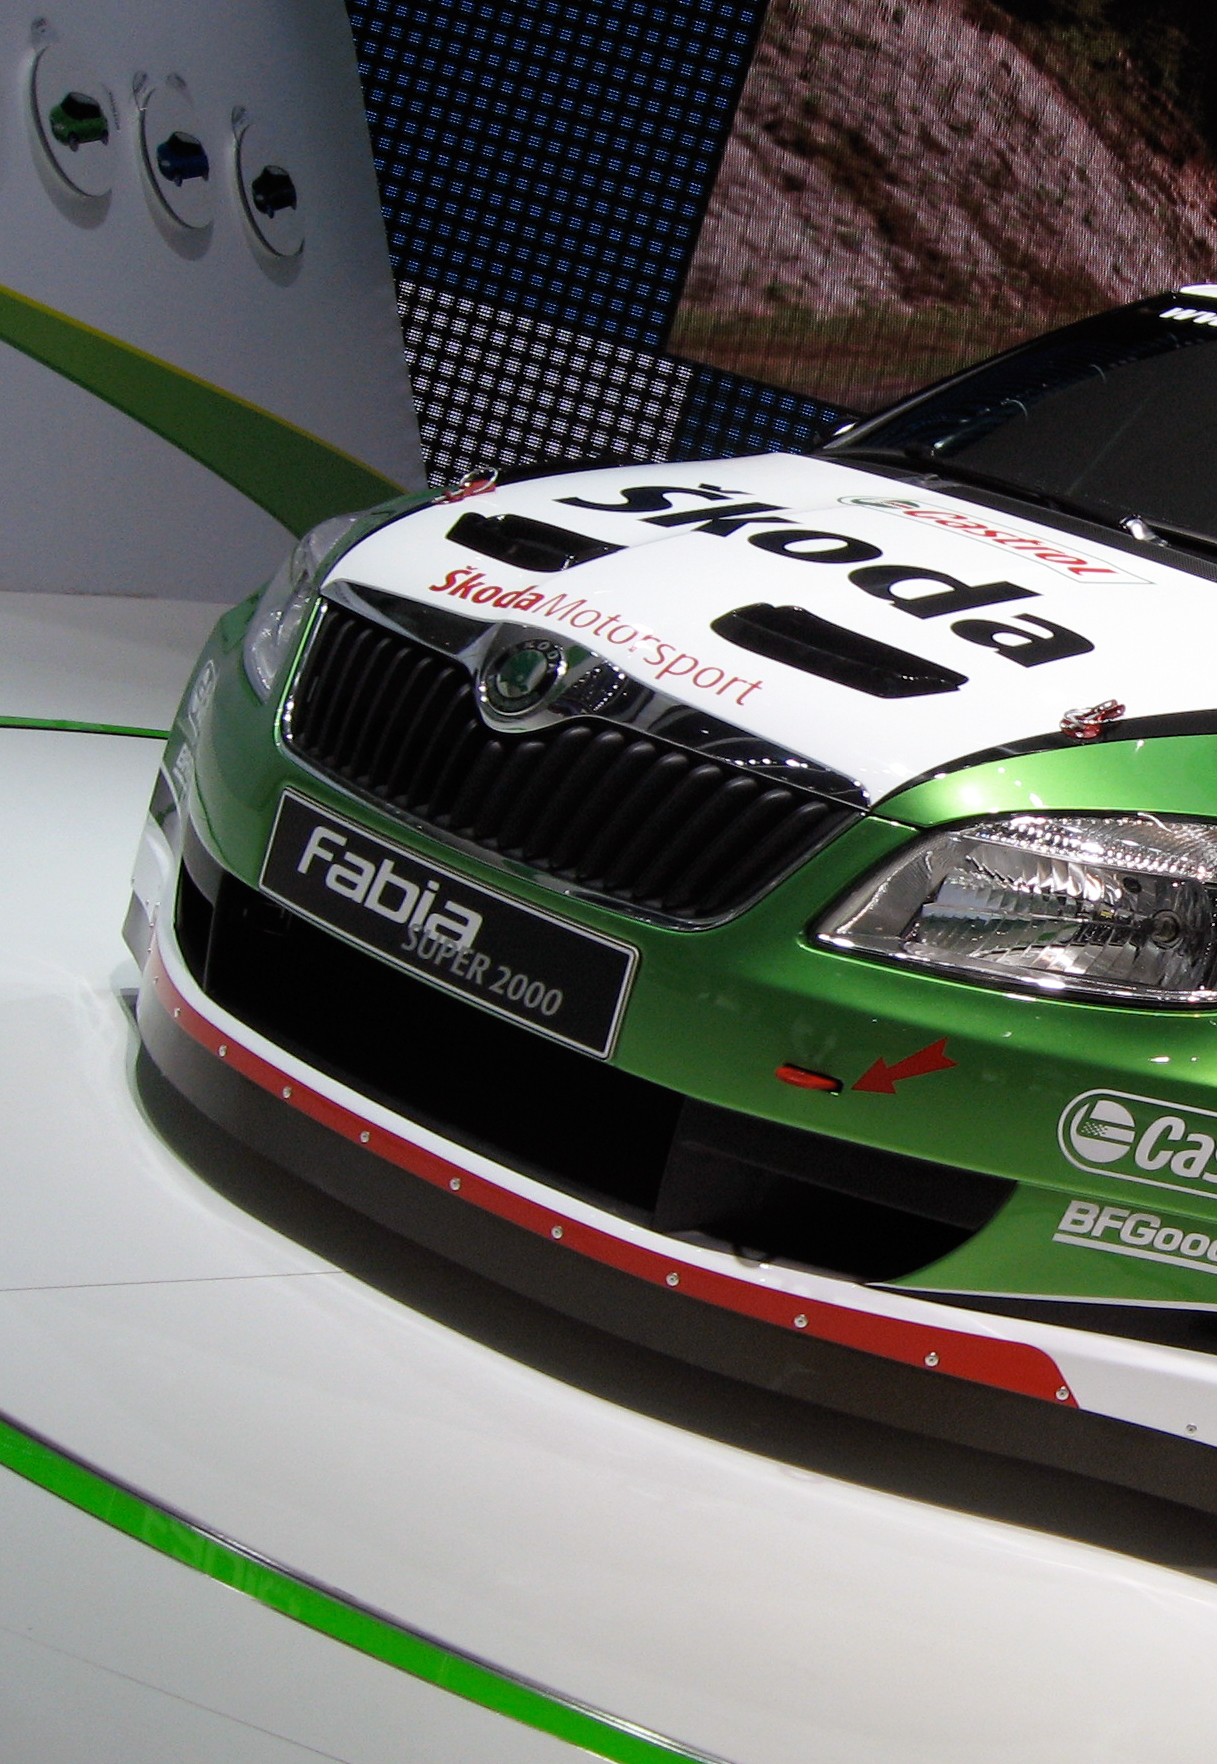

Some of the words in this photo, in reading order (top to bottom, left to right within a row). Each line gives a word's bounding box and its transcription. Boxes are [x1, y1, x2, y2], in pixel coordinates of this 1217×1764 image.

[903, 509, 1120, 576] Castrol
[297, 825, 483, 953] Fabia
[401, 923, 492, 985] SUPER
[488, 965, 564, 1016] 2000
